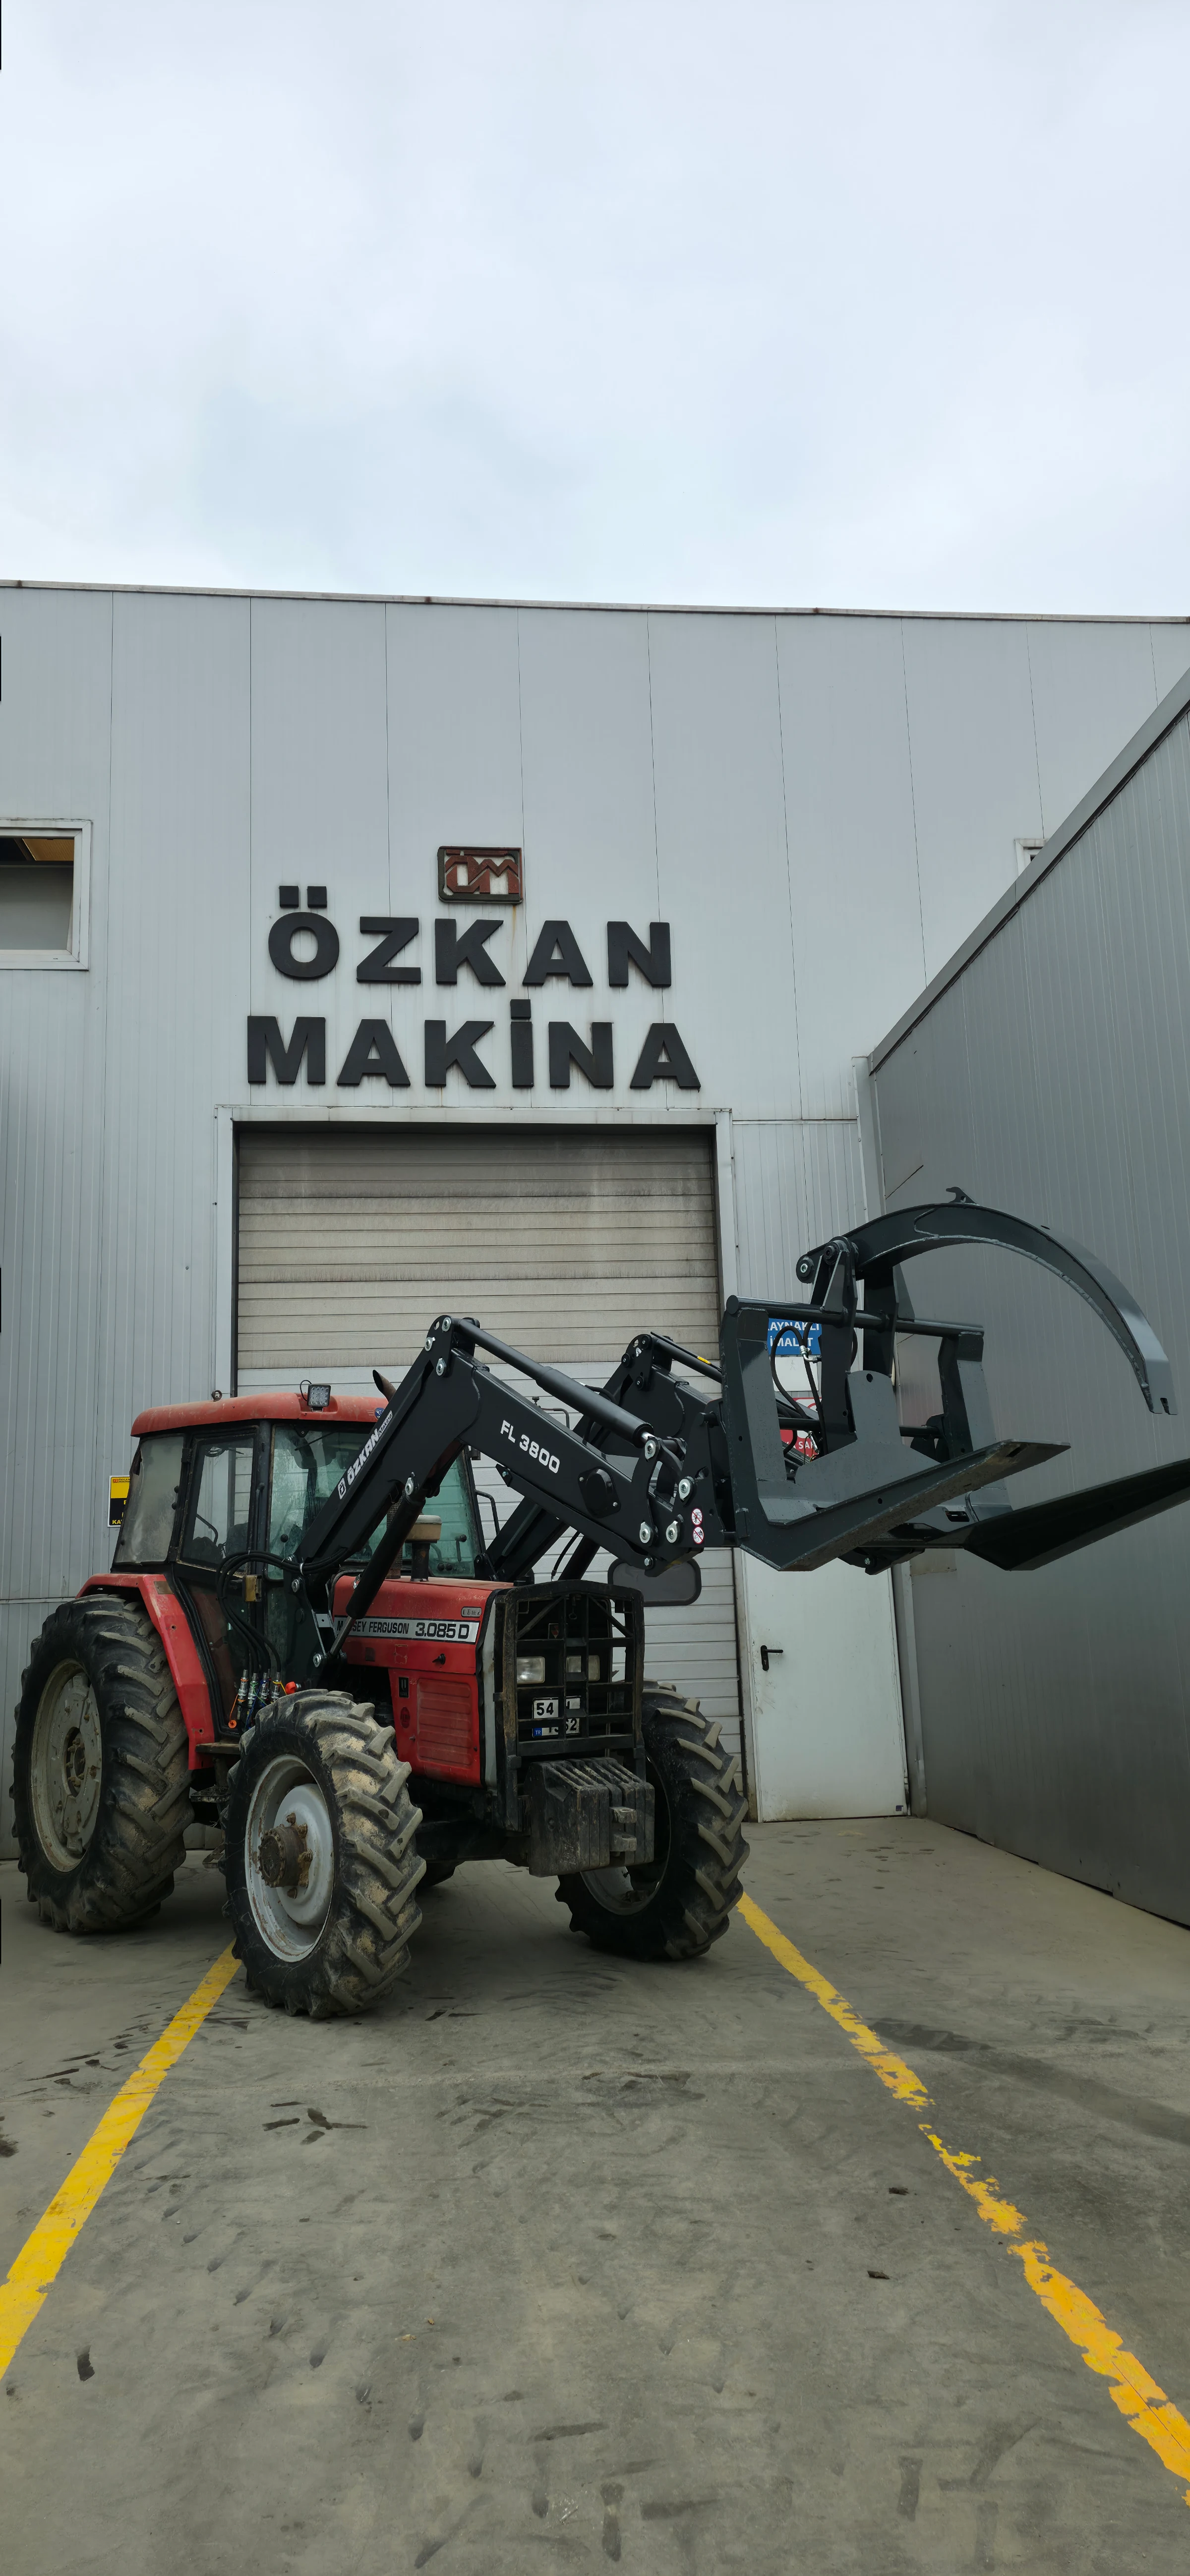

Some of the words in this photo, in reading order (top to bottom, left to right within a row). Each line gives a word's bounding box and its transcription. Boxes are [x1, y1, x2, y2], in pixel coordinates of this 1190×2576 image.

[268, 885, 672, 987] ÖZKAN
[247, 999, 701, 1089] MAKİNA
[770, 1335, 813, 1347] İMALT
[347, 1428, 379, 1486] ÖZKAN
[500, 1420, 516, 1443] FL
[519, 1434, 560, 1474] 3800
[337, 1620, 367, 1633] MSEY
[368, 1621, 409, 1635] FERGUSON
[415, 1622, 456, 1639] 3.085
[458, 1624, 470, 1639] D
[536, 1702, 554, 1716] 54
